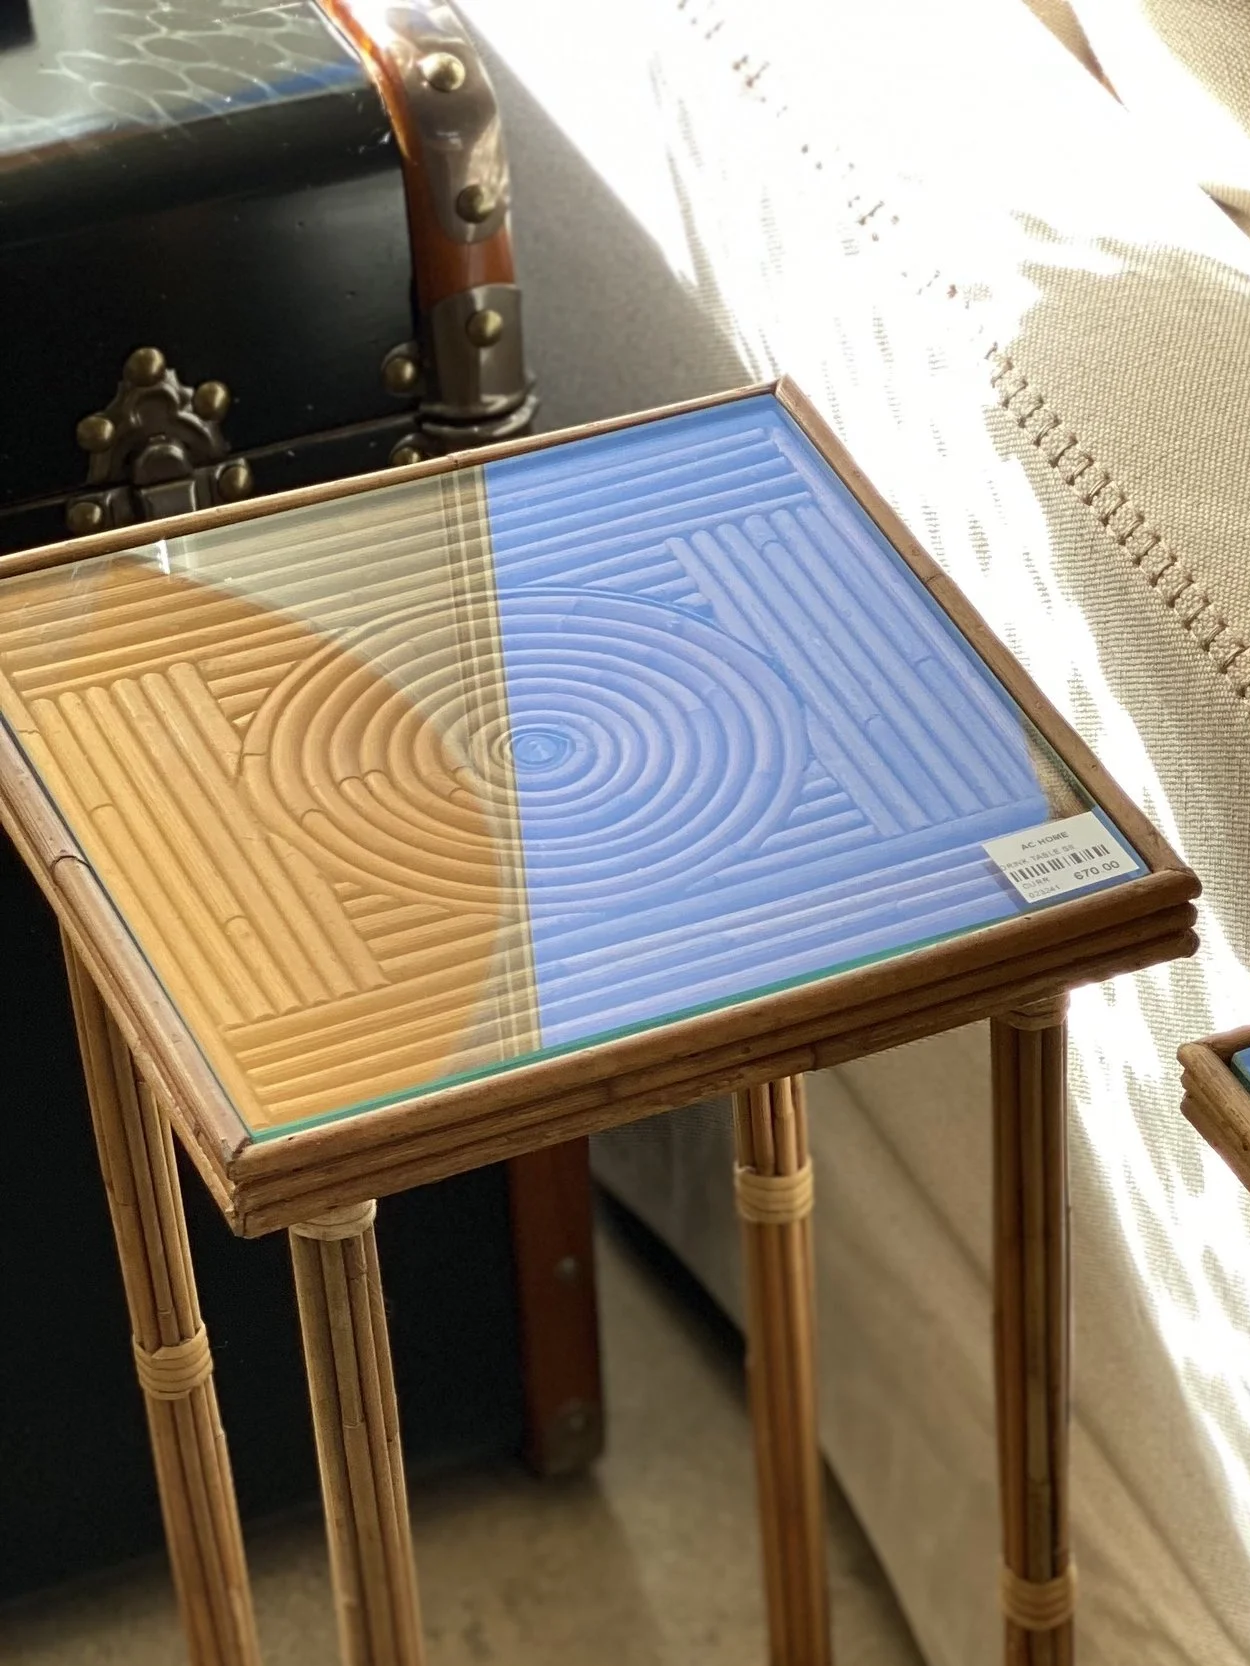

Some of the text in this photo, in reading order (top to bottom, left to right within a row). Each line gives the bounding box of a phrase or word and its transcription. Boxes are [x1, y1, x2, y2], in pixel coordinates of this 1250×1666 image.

[1022, 831, 1068, 850] AC HOME
[1000, 858, 1028, 871] DRINK
[1030, 848, 1060, 861] TABLE
[1074, 860, 1120, 880] 670.00
